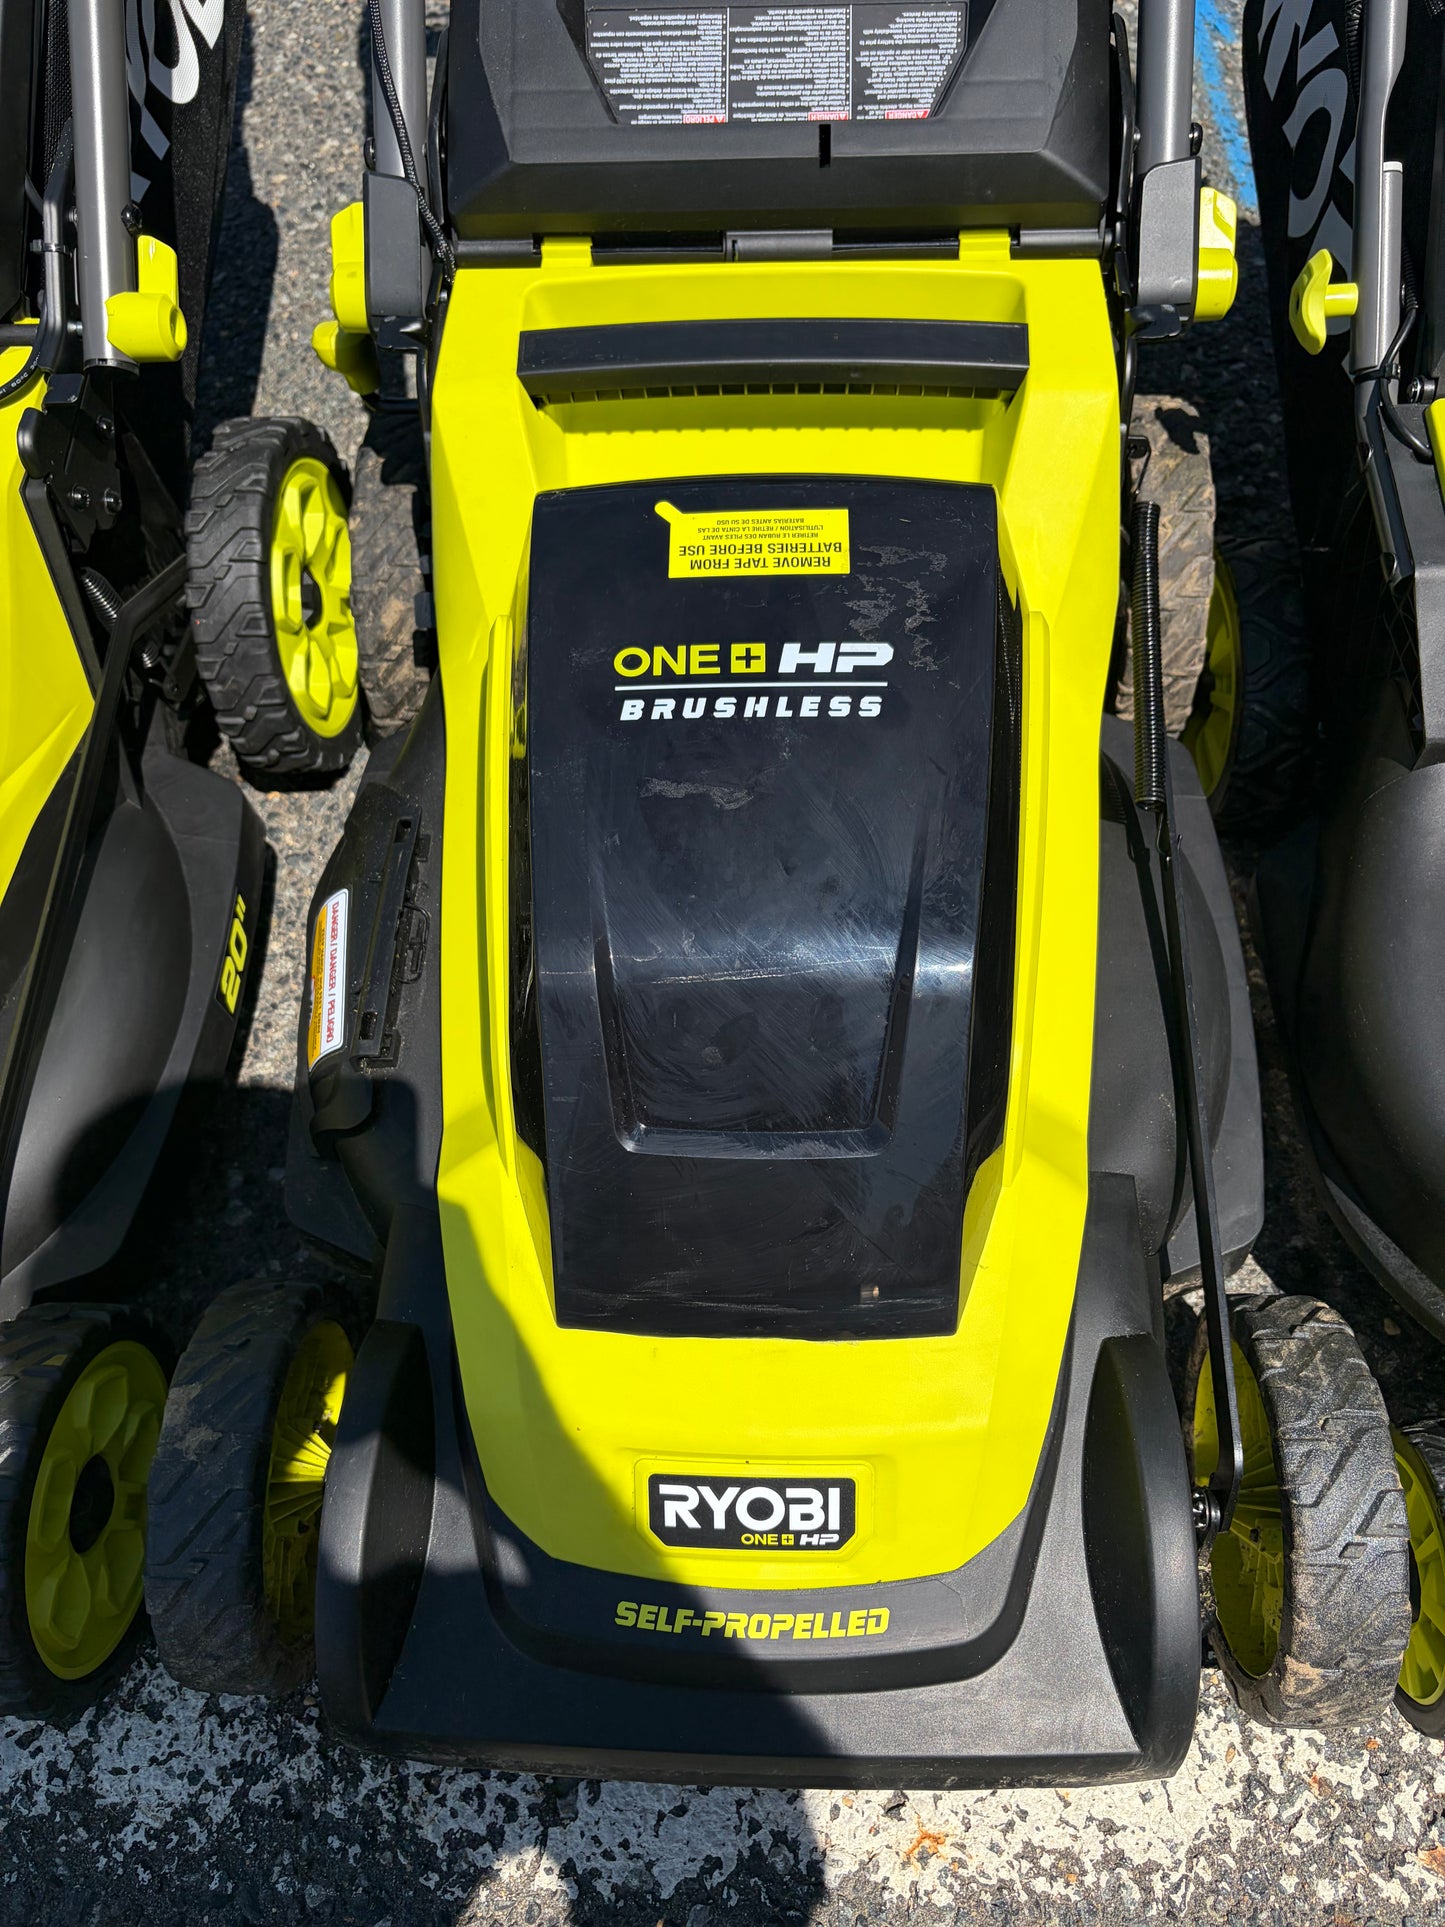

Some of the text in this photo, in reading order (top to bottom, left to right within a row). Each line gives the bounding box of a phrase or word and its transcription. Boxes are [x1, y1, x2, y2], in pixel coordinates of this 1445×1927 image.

[679, 542, 842, 556] BATTERIES BEFORE USE
[690, 556, 830, 570] REMOVE TAPE FROM
[778, 642, 894, 673] HP
[620, 696, 883, 721] BRUSHLESS
[330, 902, 339, 941] DANGER
[328, 948, 337, 990] DANGER
[326, 999, 335, 1044] PELIGRO
[659, 1484, 840, 1531] RYOBI
[799, 1533, 840, 1546] HP
[614, 1600, 890, 1640] SELF-PROPELLED
